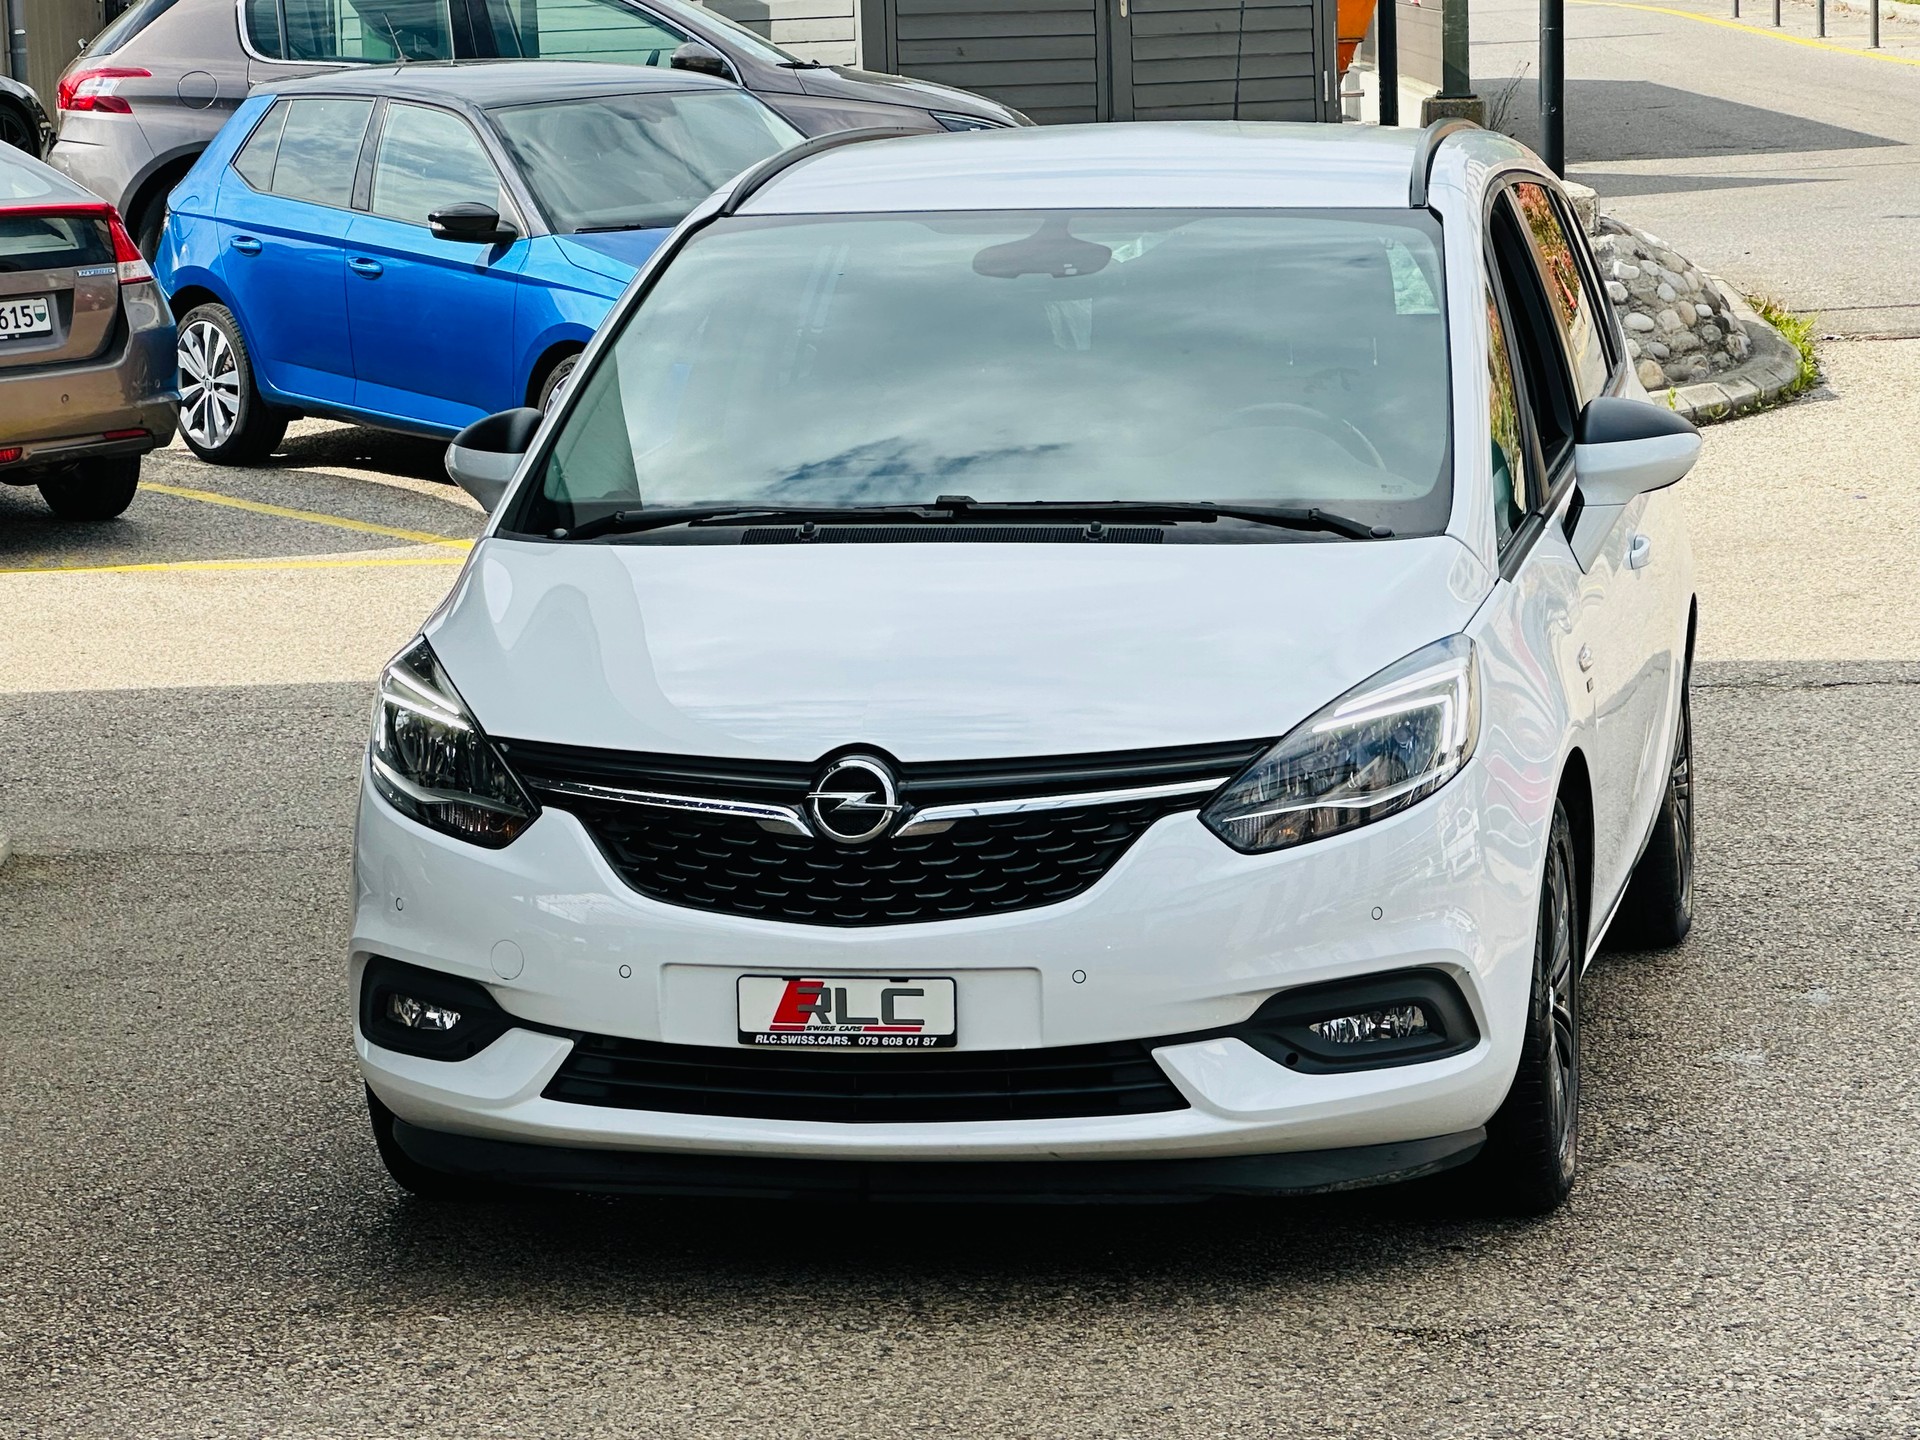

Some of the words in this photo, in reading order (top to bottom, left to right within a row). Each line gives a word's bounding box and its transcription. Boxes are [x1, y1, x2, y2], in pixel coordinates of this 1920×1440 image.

[80, 268, 114, 276] HYBRID
[0, 305, 34, 330] 615
[797, 987, 925, 1025] RLC
[858, 1036, 879, 1046] 079
[882, 1036, 903, 1046] 608
[906, 1037, 919, 1046] 01
[923, 1037, 937, 1046] 87
